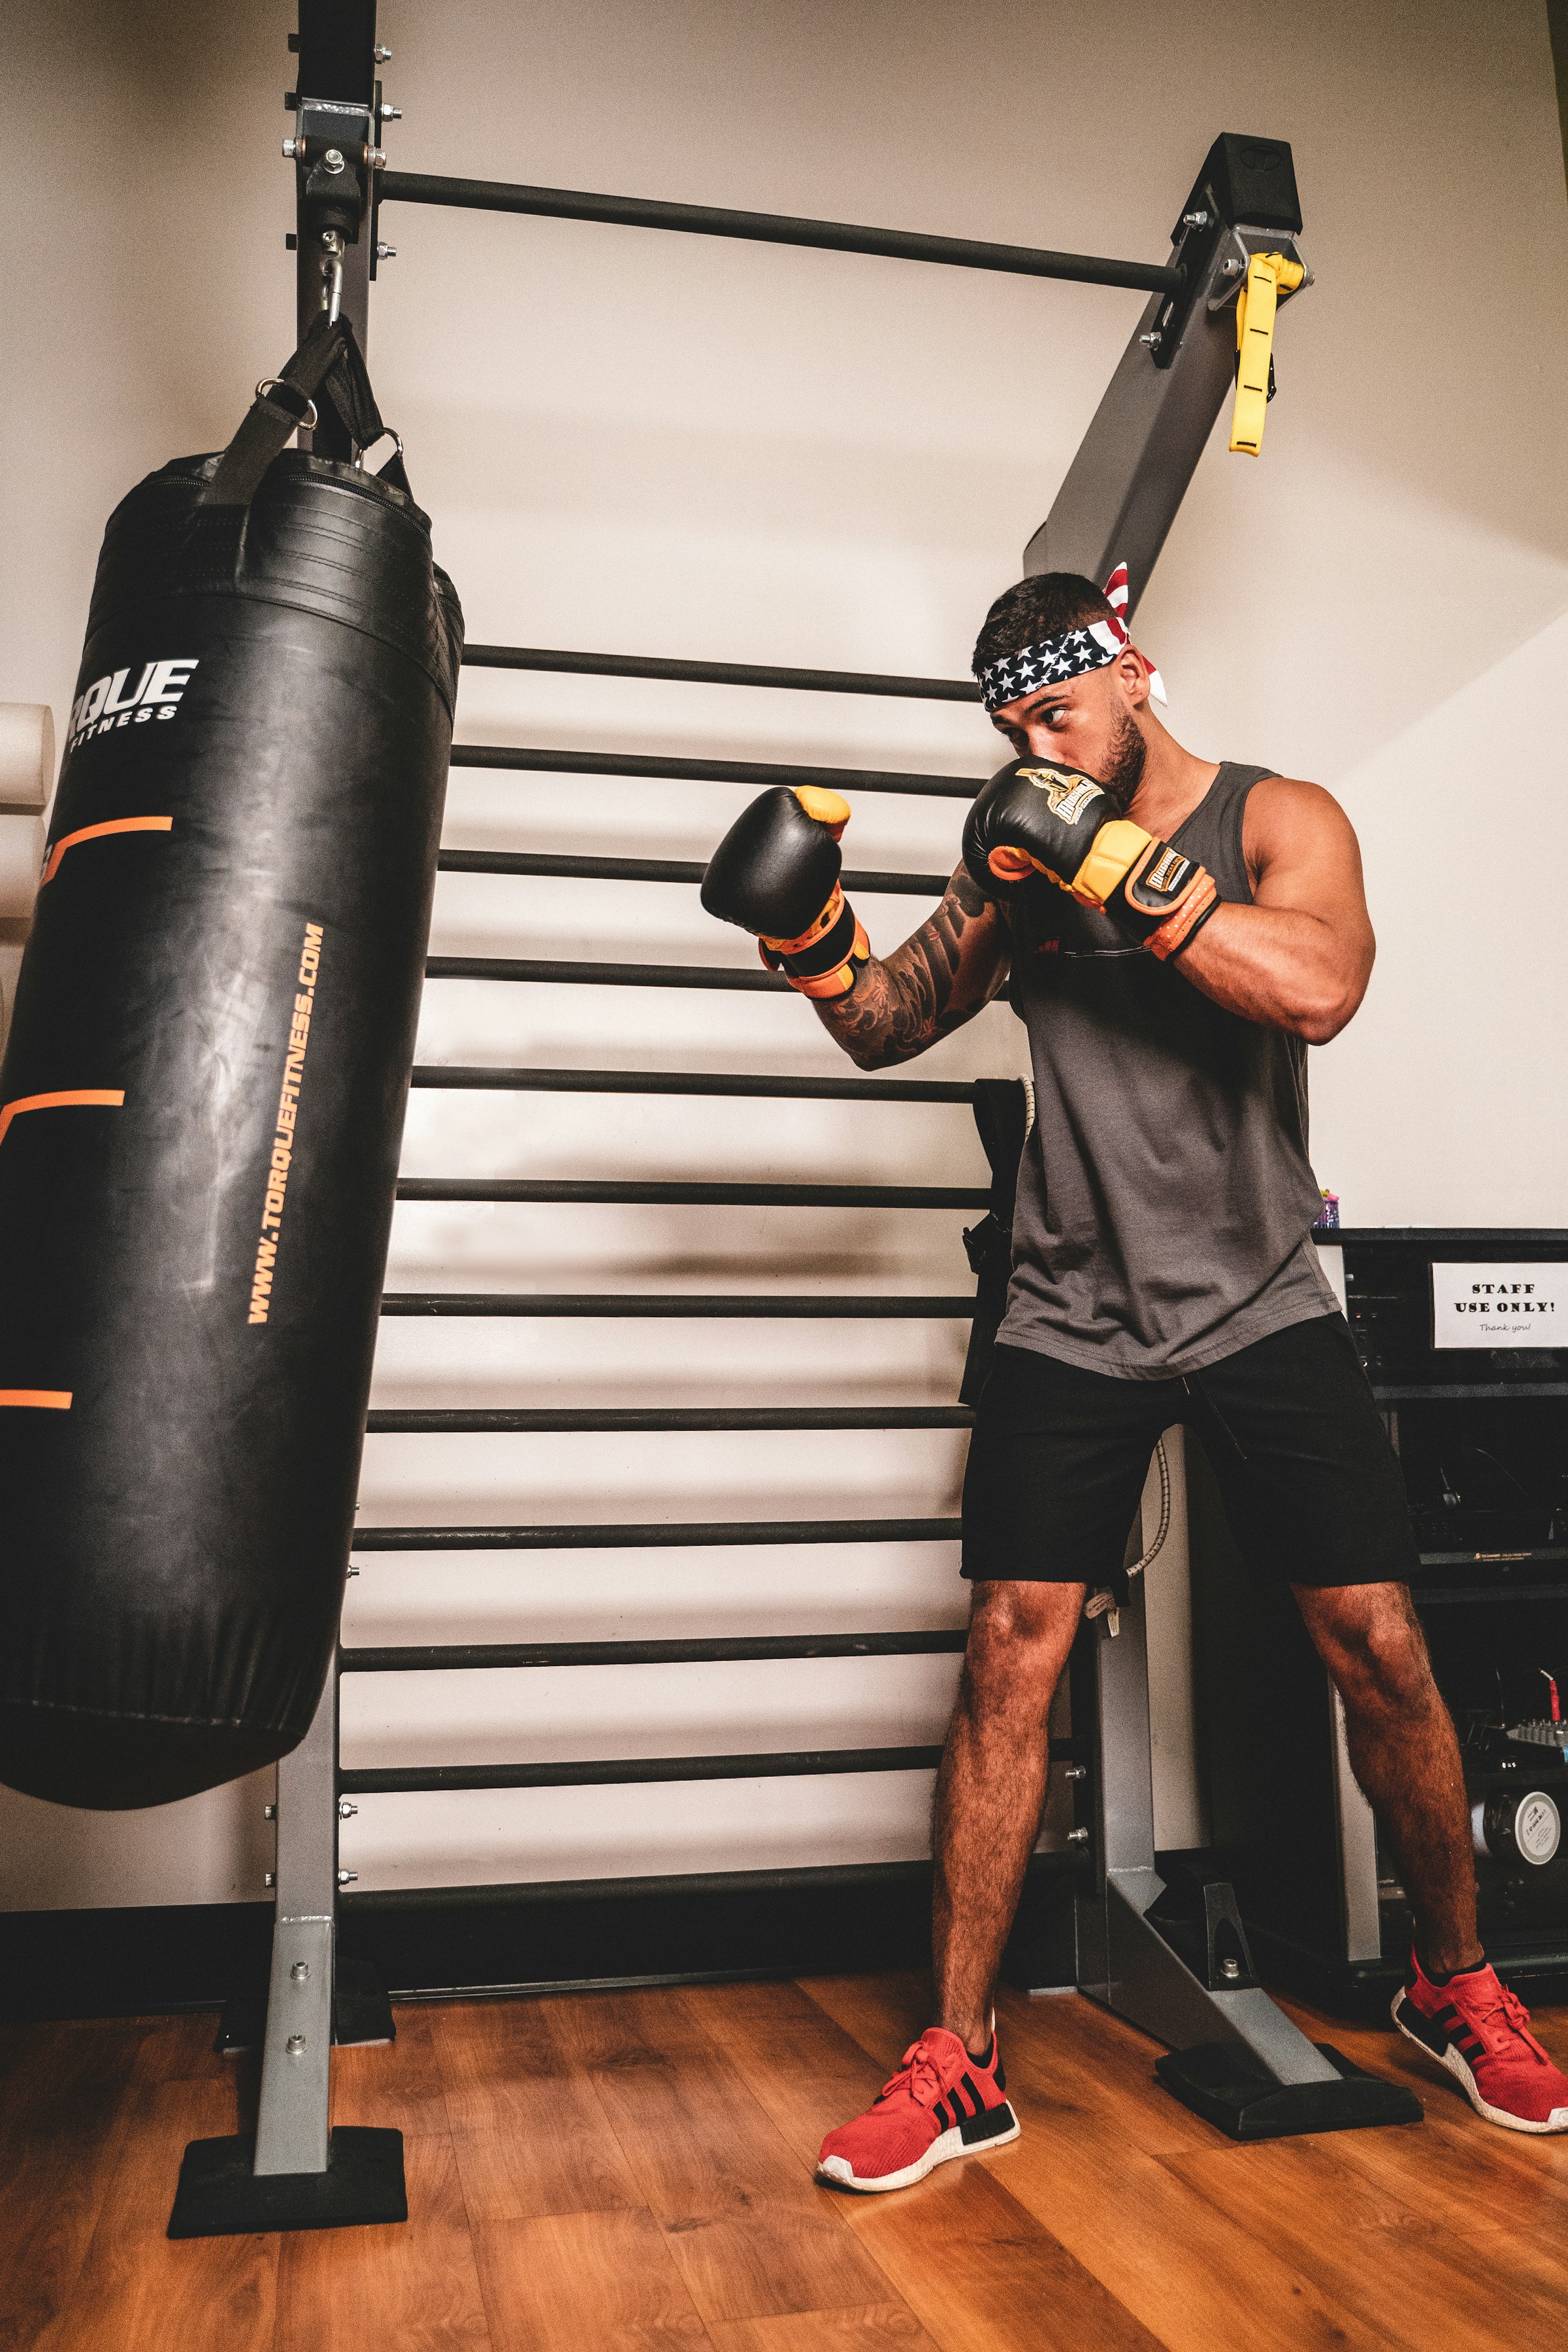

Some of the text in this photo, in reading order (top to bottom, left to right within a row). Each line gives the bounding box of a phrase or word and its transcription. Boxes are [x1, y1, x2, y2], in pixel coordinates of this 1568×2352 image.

[70, 706, 178, 753] FITNESS
[248, 923, 324, 1325] WWW.TORQUEFITNESS.COM
[1471, 1284, 1535, 1294] STAFF
[1454, 1302, 1555, 1313] USE ONLY!
[1511, 1324, 1531, 1333] you!
